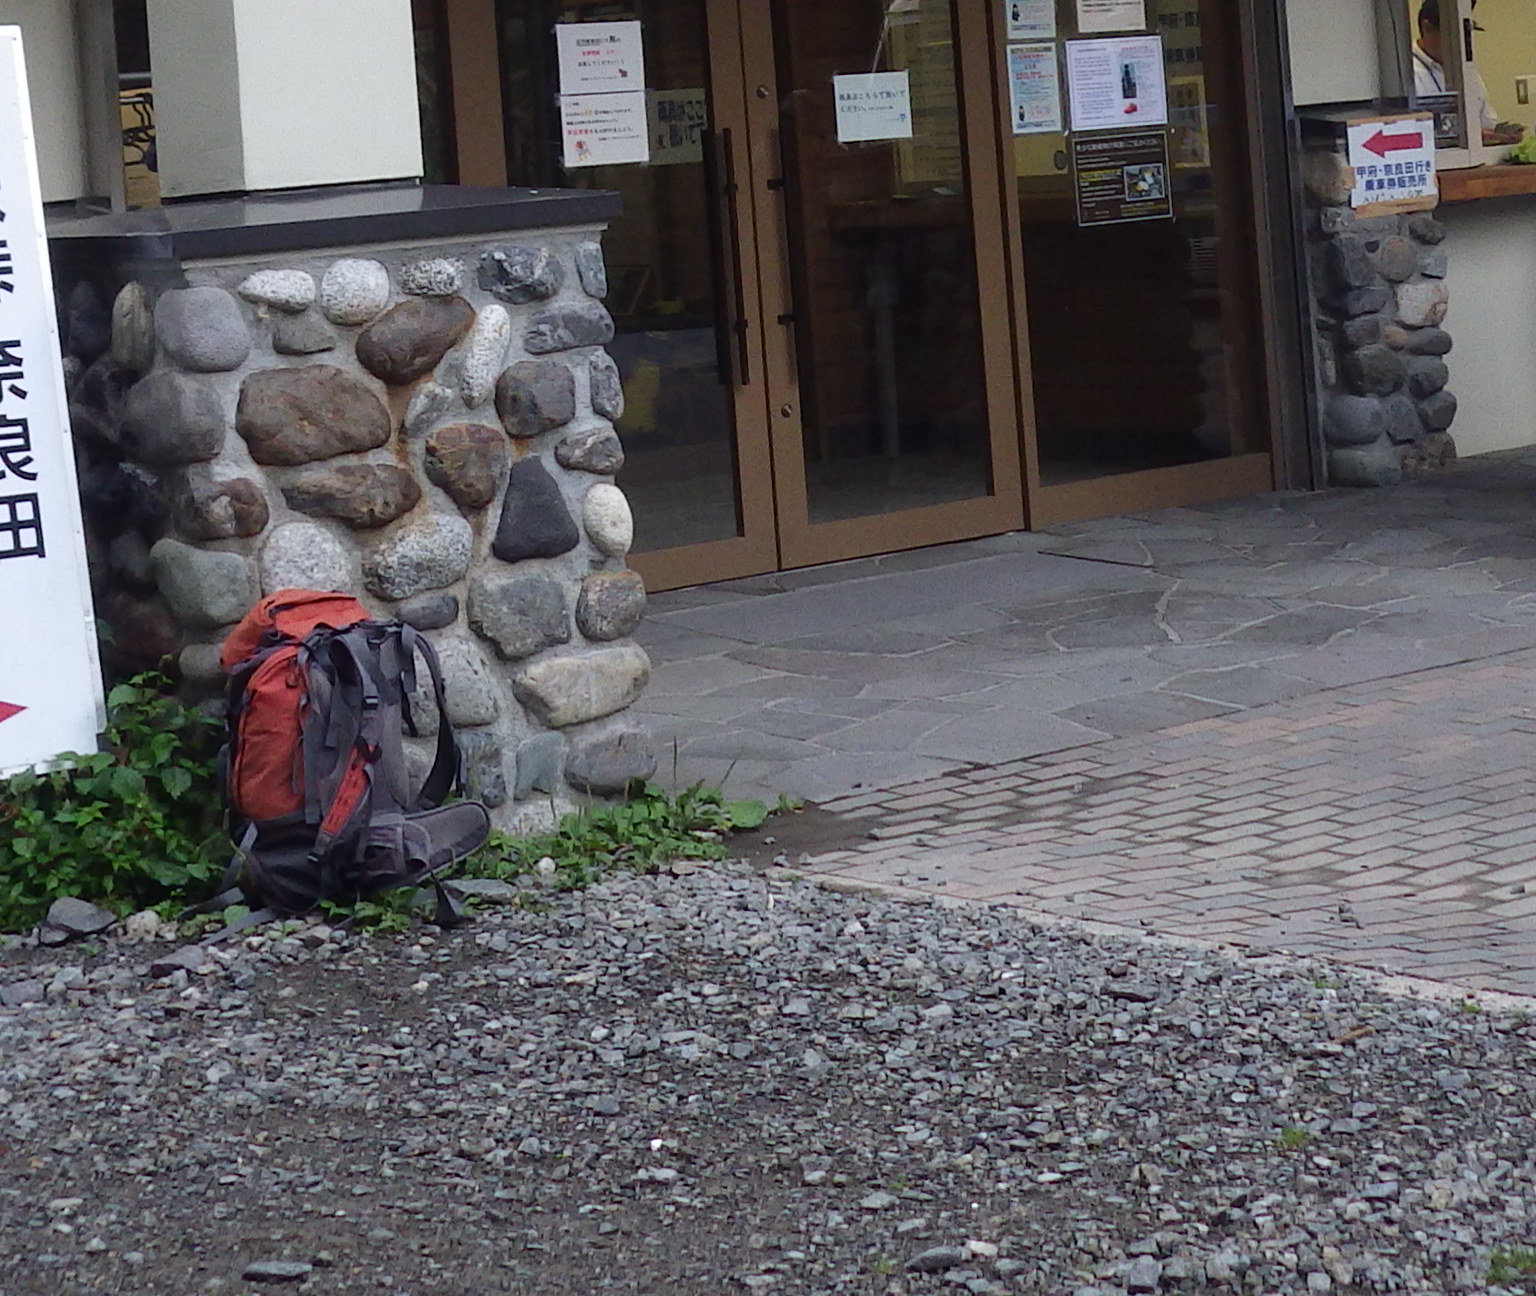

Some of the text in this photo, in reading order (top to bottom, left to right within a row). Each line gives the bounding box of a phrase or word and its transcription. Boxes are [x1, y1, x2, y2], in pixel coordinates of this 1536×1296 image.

[1356, 160, 1432, 179] 甲府・奈良田行き
